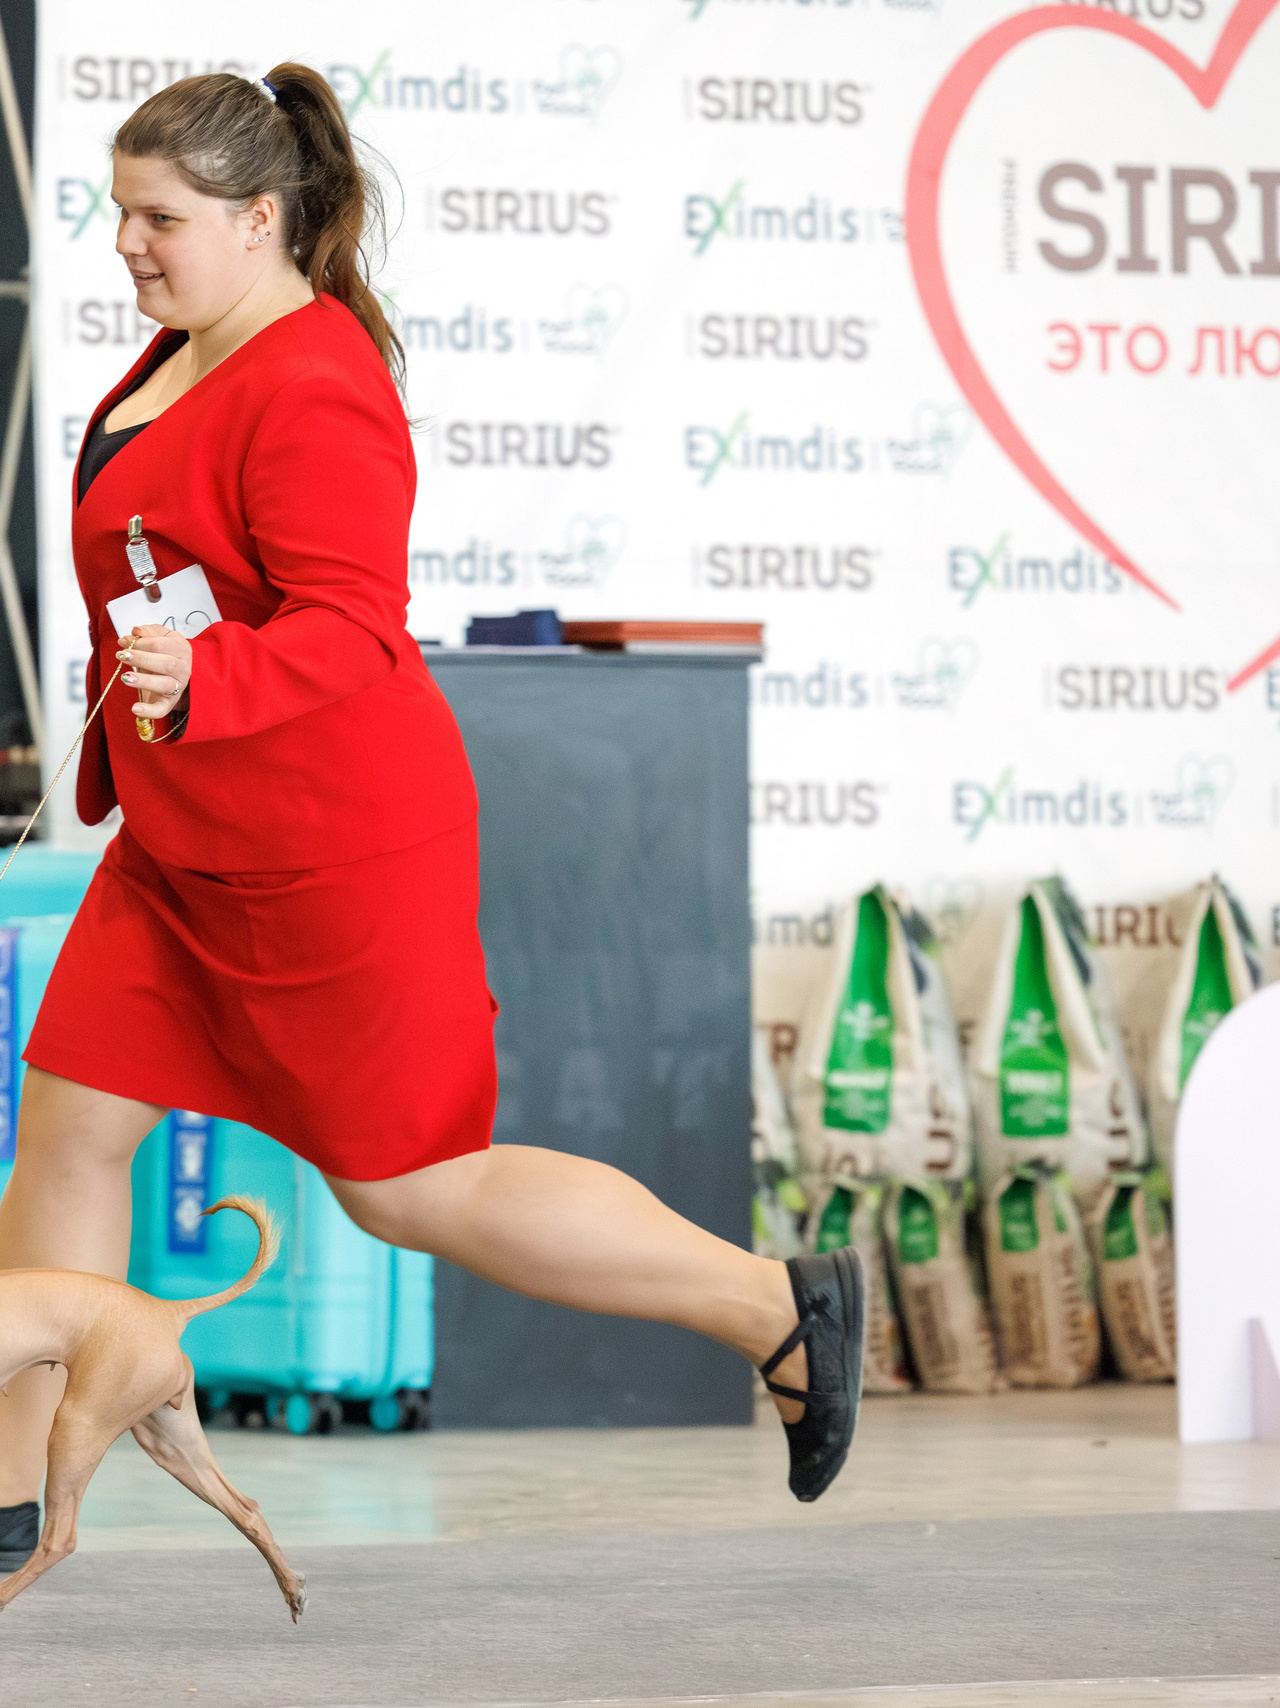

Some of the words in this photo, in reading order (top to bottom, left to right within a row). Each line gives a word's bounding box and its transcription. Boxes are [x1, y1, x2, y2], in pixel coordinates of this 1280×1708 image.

[699, 77, 863, 126] SIRIUS
[441, 188, 610, 236] SIRIUS
[1037, 161, 1280, 278] SIRI
[700, 315, 869, 362] SIRIUS
[1047, 321, 1170, 375] ЭТО
[446, 422, 612, 469] SIRIUS
[706, 545, 874, 591] SIRIUS
[1058, 666, 1220, 712] SIRIUS
